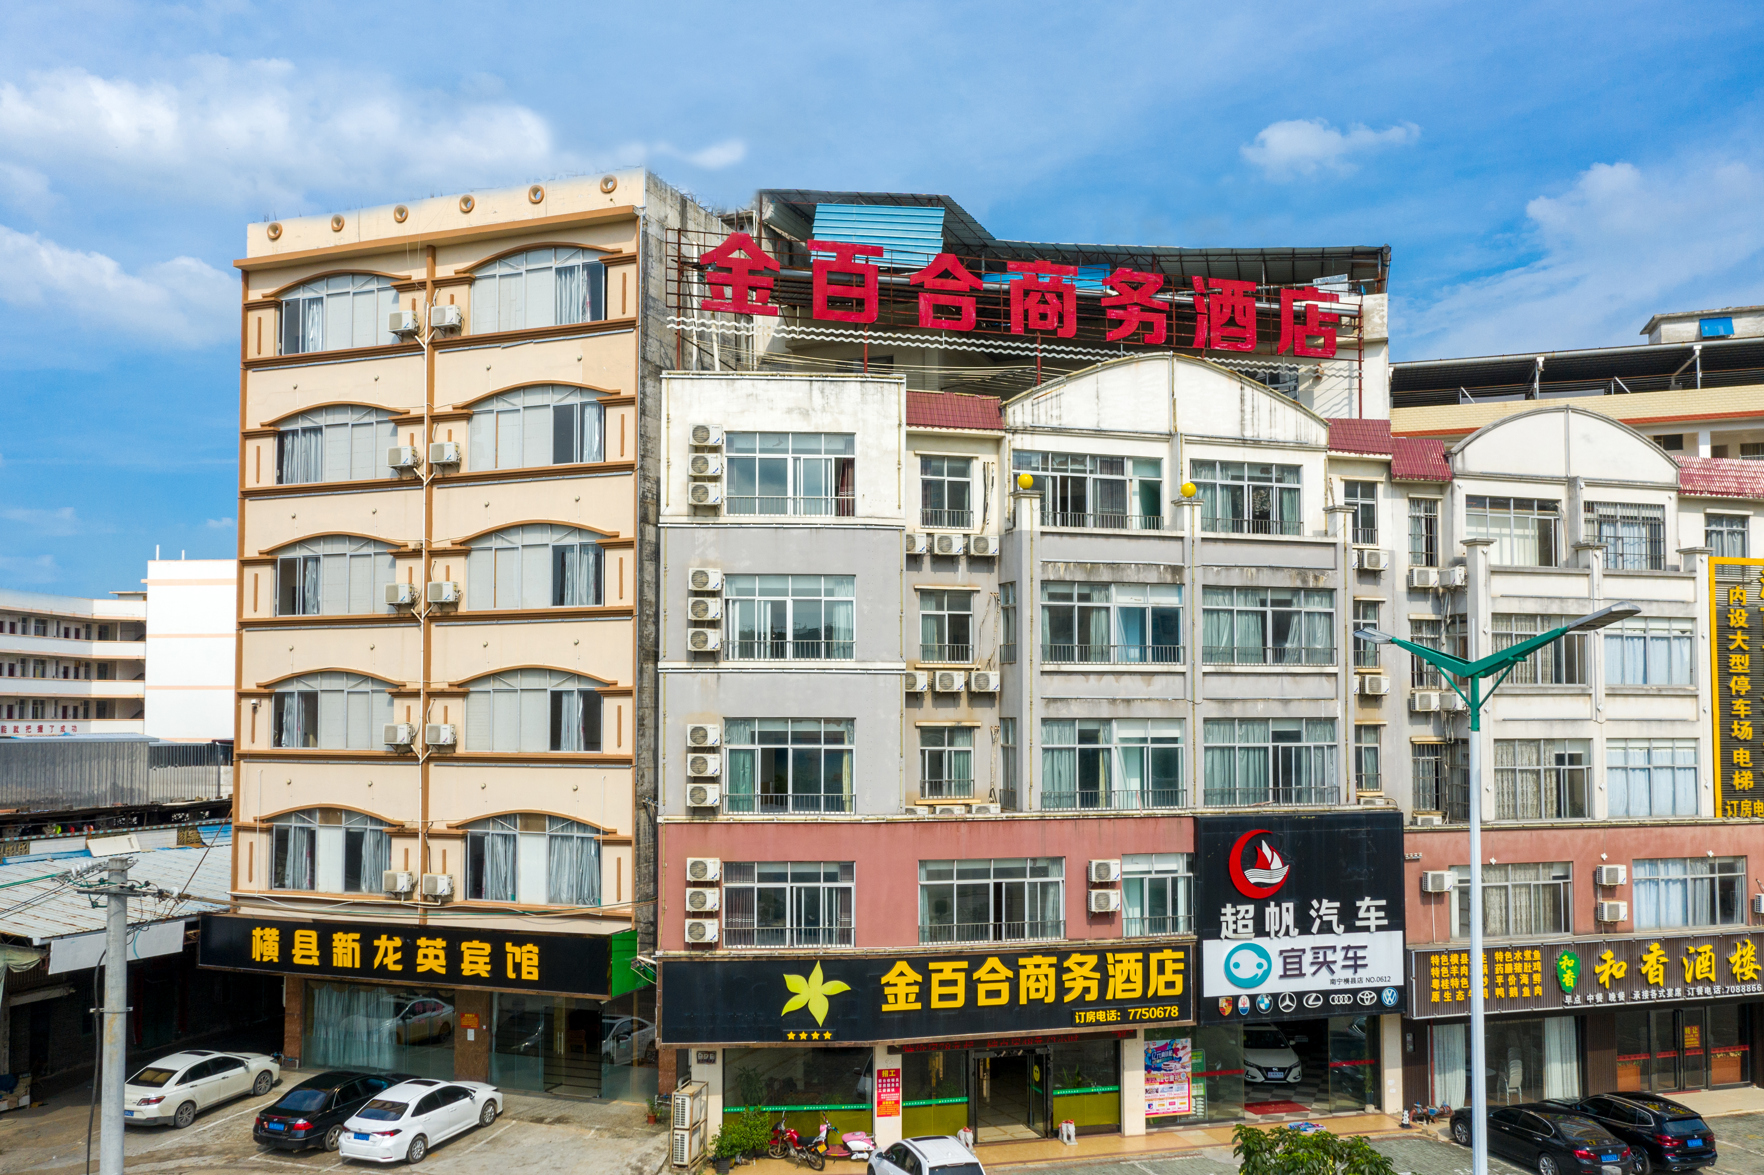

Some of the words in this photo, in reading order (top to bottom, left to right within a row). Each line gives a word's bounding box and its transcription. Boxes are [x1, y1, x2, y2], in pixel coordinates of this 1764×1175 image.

[699, 231, 1340, 359] 金百合商务酒店
[1727, 585, 1754, 740] 内设大型停车场
[1732, 747, 1754, 791] 电梯
[1220, 896, 1389, 940] 超帆汽车
[251, 926, 540, 982] 横县新龙英宾馆
[1278, 944, 1369, 980] 宜买车
[1494, 949, 1541, 963] 特色水煮鱼
[1559, 954, 1576, 988] 和香
[1594, 938, 1763, 989] 和香酒楼
[880, 948, 1186, 1012] 金百合商务酒店
[1329, 977, 1364, 986] 南宁横县店
[1495, 973, 1542, 987] 平价海鲜
[1564, 994, 1582, 1006] 早点
[1586, 992, 1604, 1004] 中餐
[1608, 991, 1626, 1003] 晚餐
[1127, 1005, 1179, 1020] 7750678
